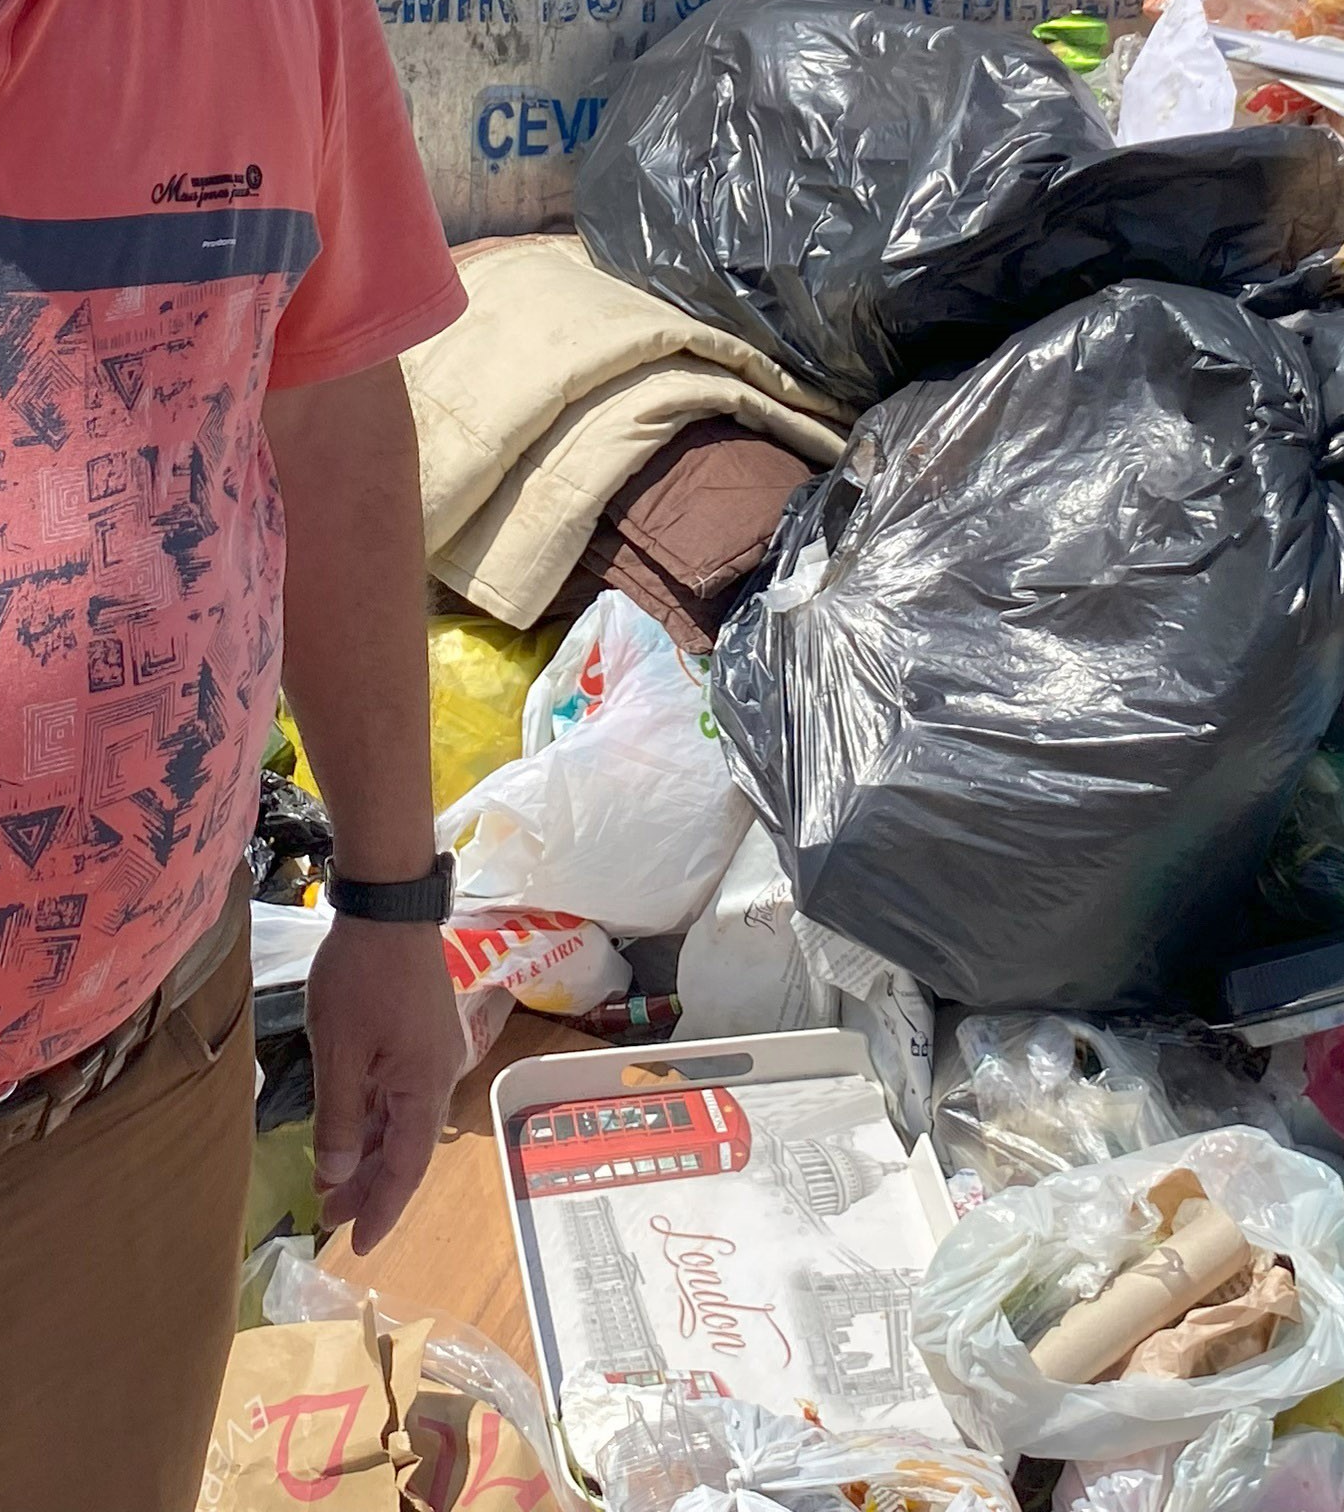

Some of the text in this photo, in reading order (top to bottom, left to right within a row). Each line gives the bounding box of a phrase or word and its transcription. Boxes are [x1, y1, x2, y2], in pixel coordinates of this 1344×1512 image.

[530, 962, 542, 978] &
[543, 933, 585, 968] FIRIN
[649, 1215, 792, 1369] London
